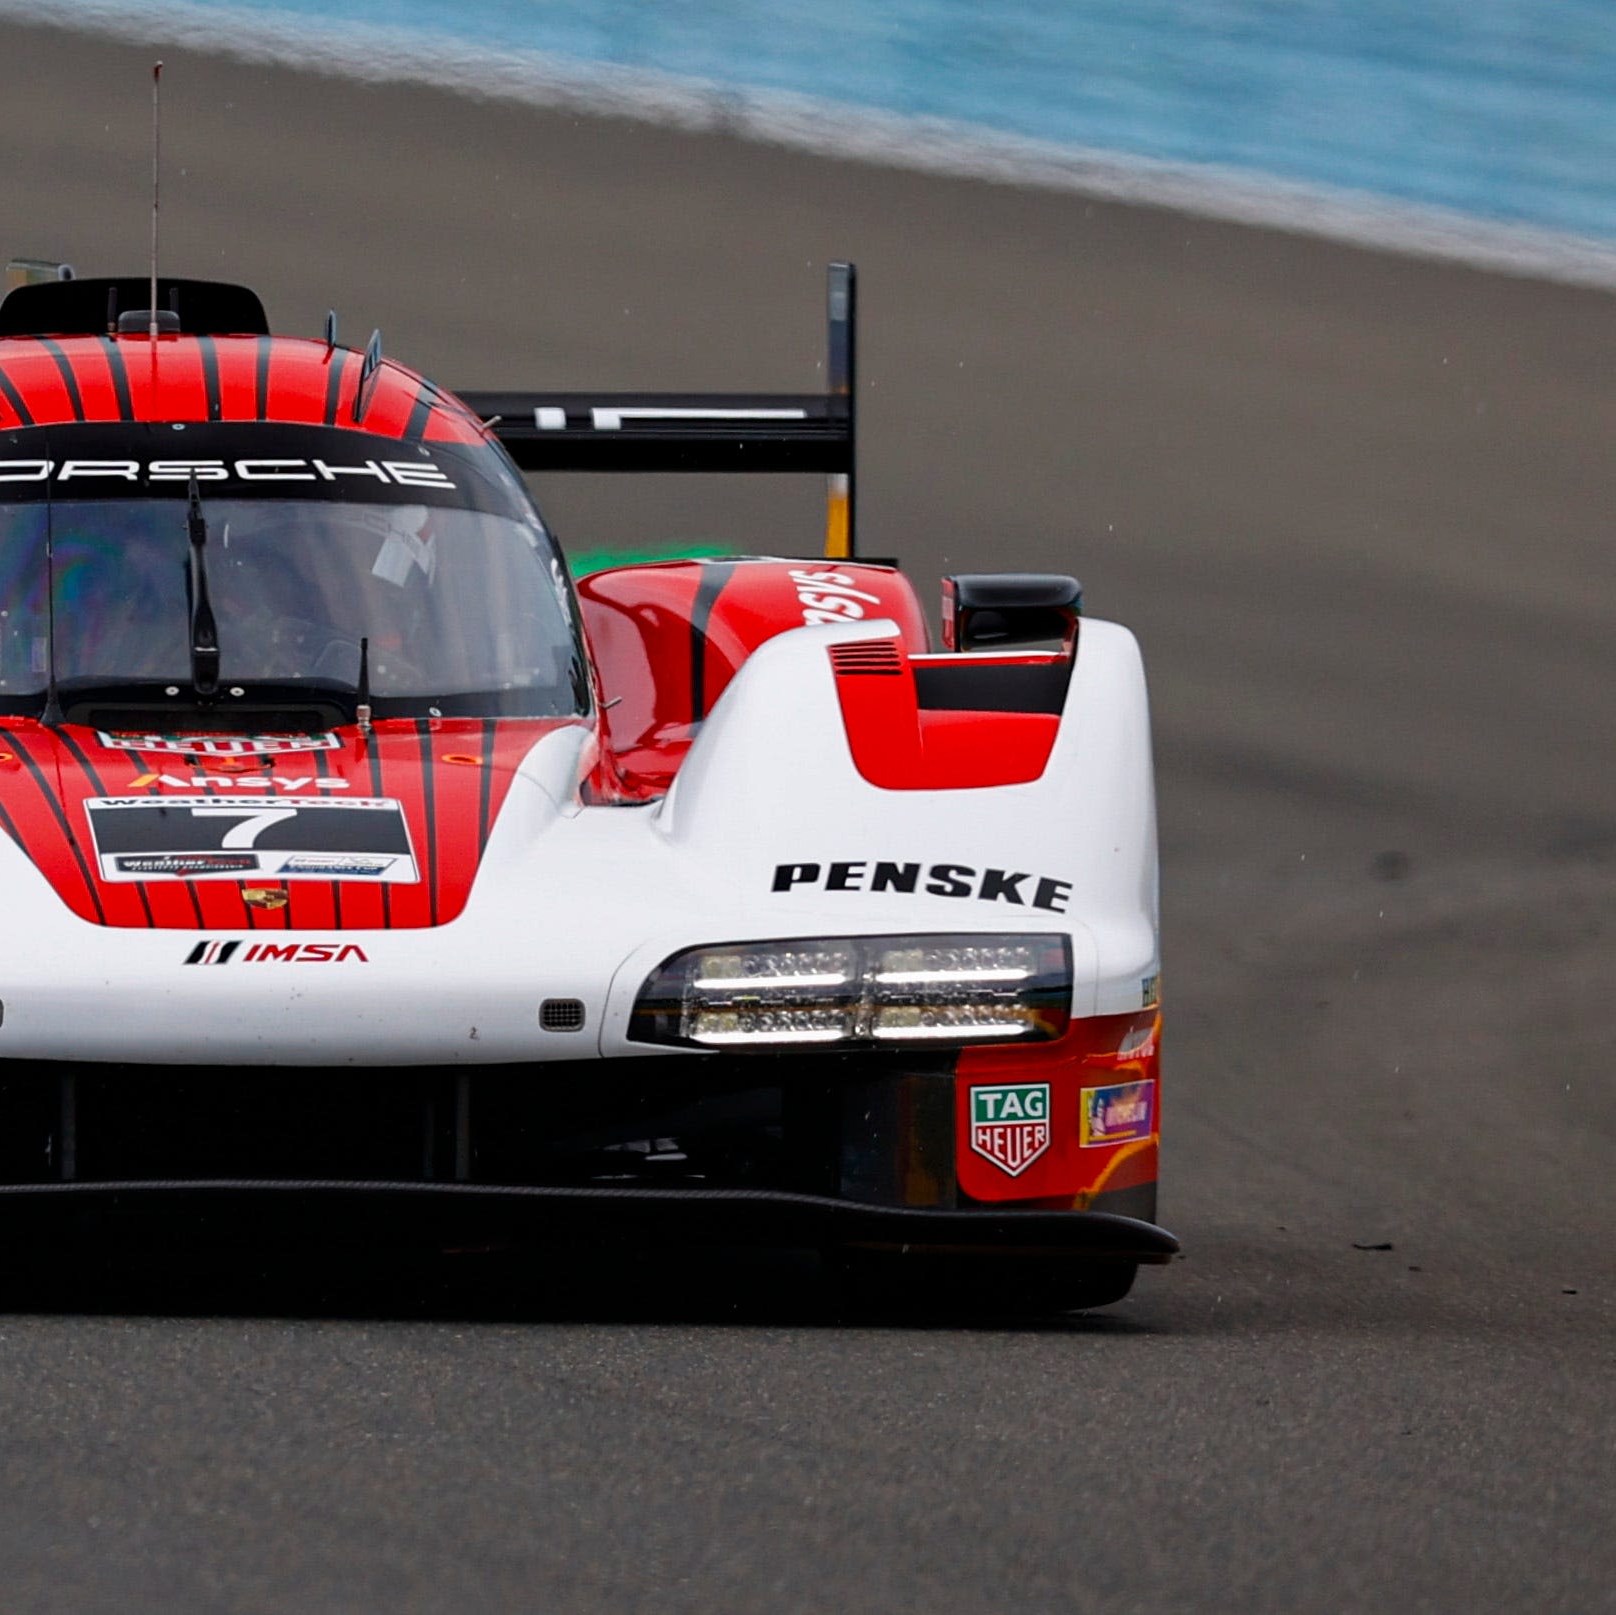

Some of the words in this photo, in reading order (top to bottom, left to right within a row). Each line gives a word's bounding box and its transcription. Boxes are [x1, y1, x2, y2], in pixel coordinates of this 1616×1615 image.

[128, 773, 351, 791] Ansys
[100, 797, 381, 808] WeatherTech
[191, 808, 298, 849] 7
[771, 860, 1074, 914] PENSKE
[242, 943, 370, 964] IMSA
[978, 1090, 1044, 1119] TAG
[977, 1125, 1046, 1169] HEUER
